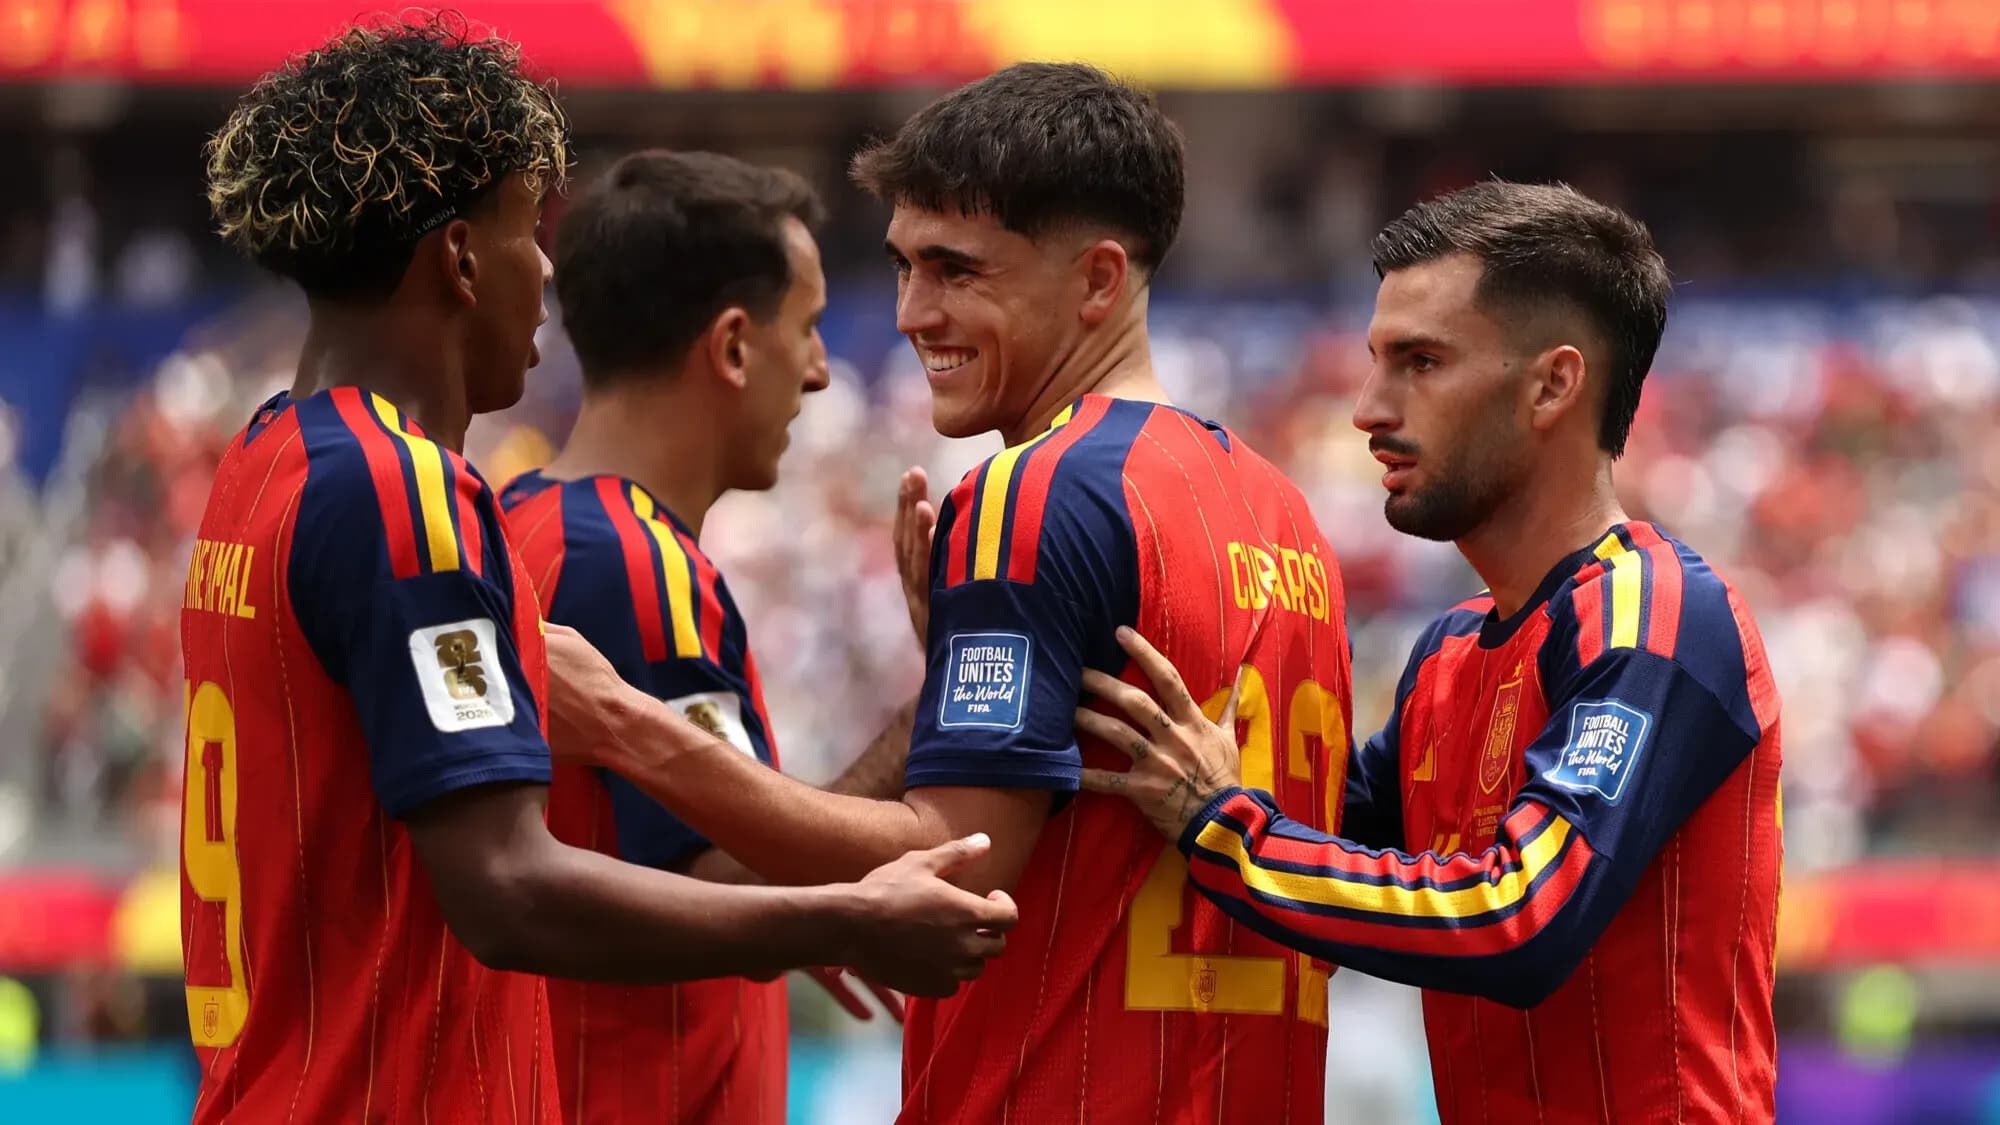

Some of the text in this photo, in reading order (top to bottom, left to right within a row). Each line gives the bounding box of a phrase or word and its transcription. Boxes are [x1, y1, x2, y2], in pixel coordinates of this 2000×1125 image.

[961, 646, 1015, 662] FOOTBALL
[958, 662, 1014, 683] UNITES
[953, 683, 1016, 704] the World
[967, 703, 991, 713] FIFA
[1583, 714, 1629, 737] FOOTBALL
[1576, 728, 1626, 756] UNITES
[1567, 749, 1623, 775] the World
[1577, 766, 1599, 777] FIFA
